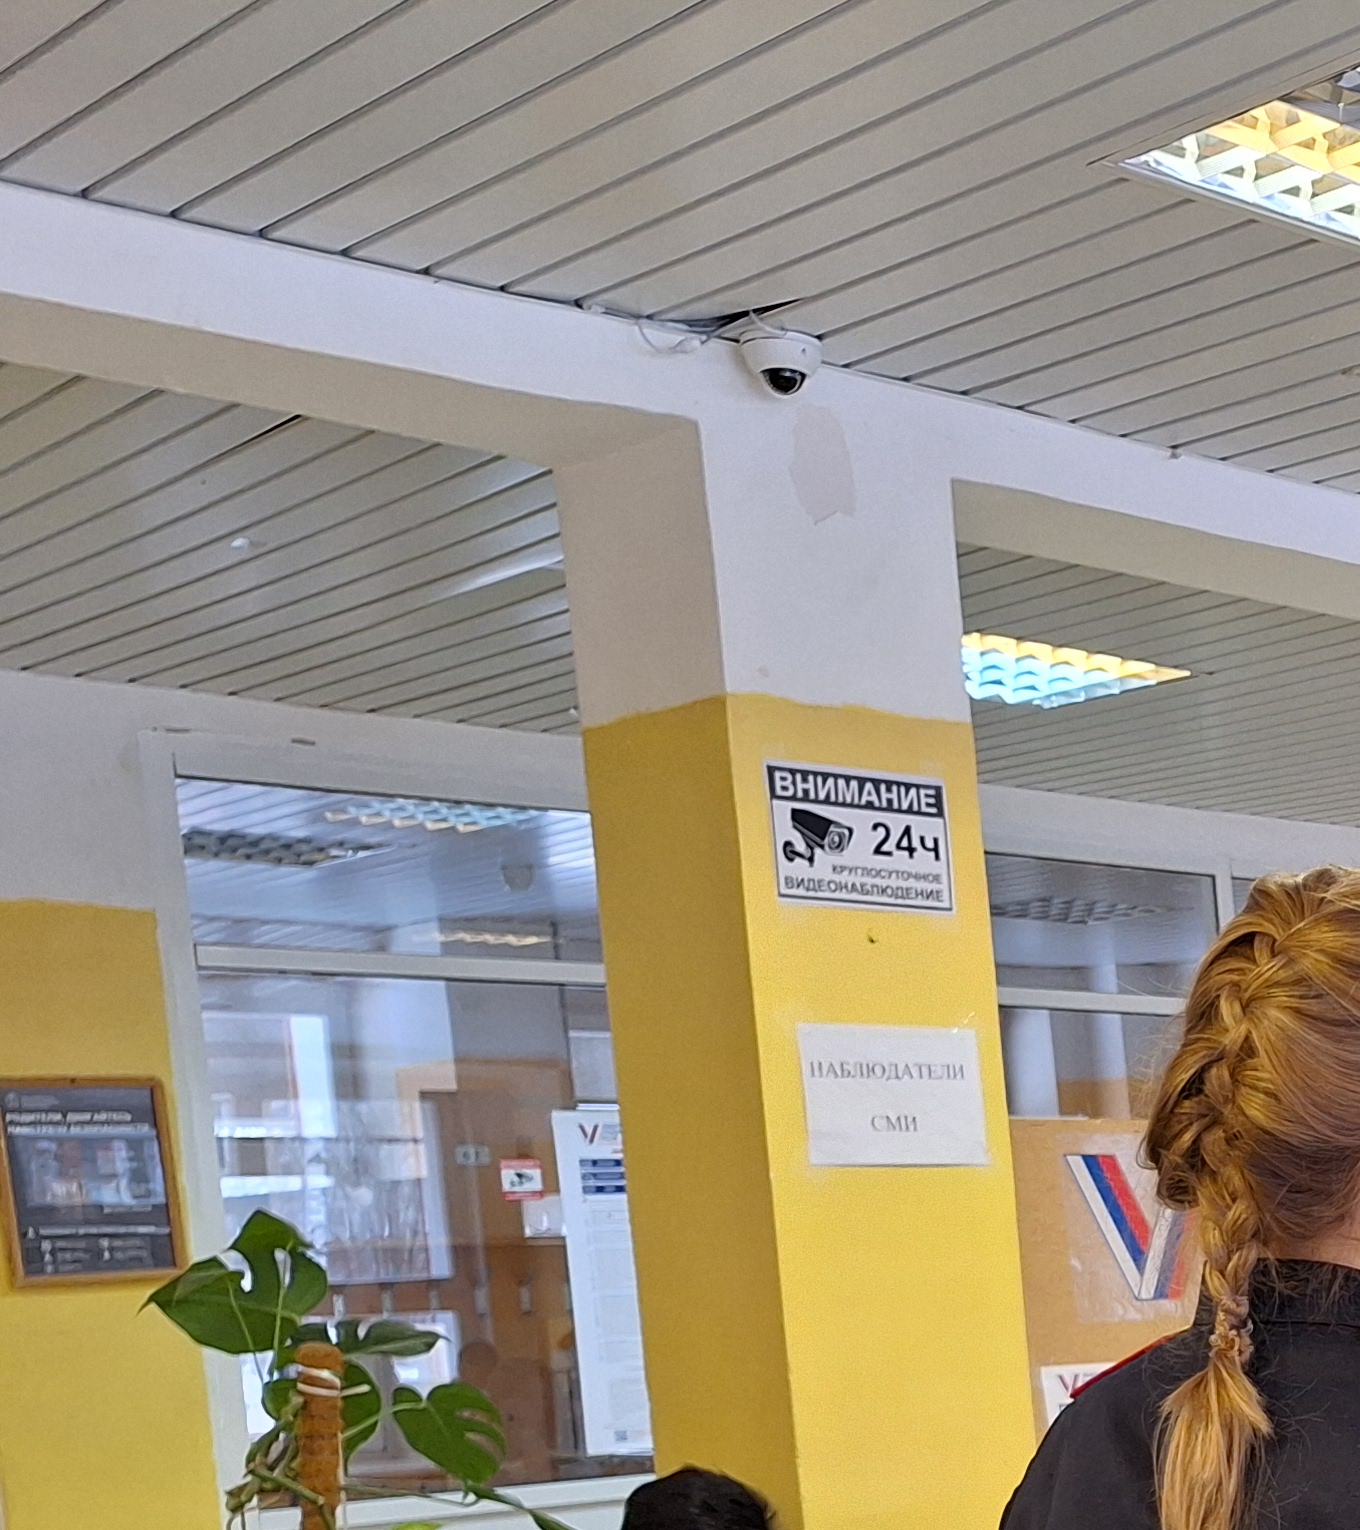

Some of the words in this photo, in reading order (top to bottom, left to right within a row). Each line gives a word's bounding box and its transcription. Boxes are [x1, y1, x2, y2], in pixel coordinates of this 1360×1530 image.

[773, 769, 938, 814] ВНИМАНИЕ
[871, 822, 941, 862] 24ч
[832, 864, 942, 884] КРУГЛОСУТОЧНОЕ
[784, 876, 944, 902] ВИДЕОНАБЛЮДЕНИЕ
[809, 1060, 965, 1081] НАБЛЮДАТЕЛИ
[870, 1115, 918, 1133] СМИ
